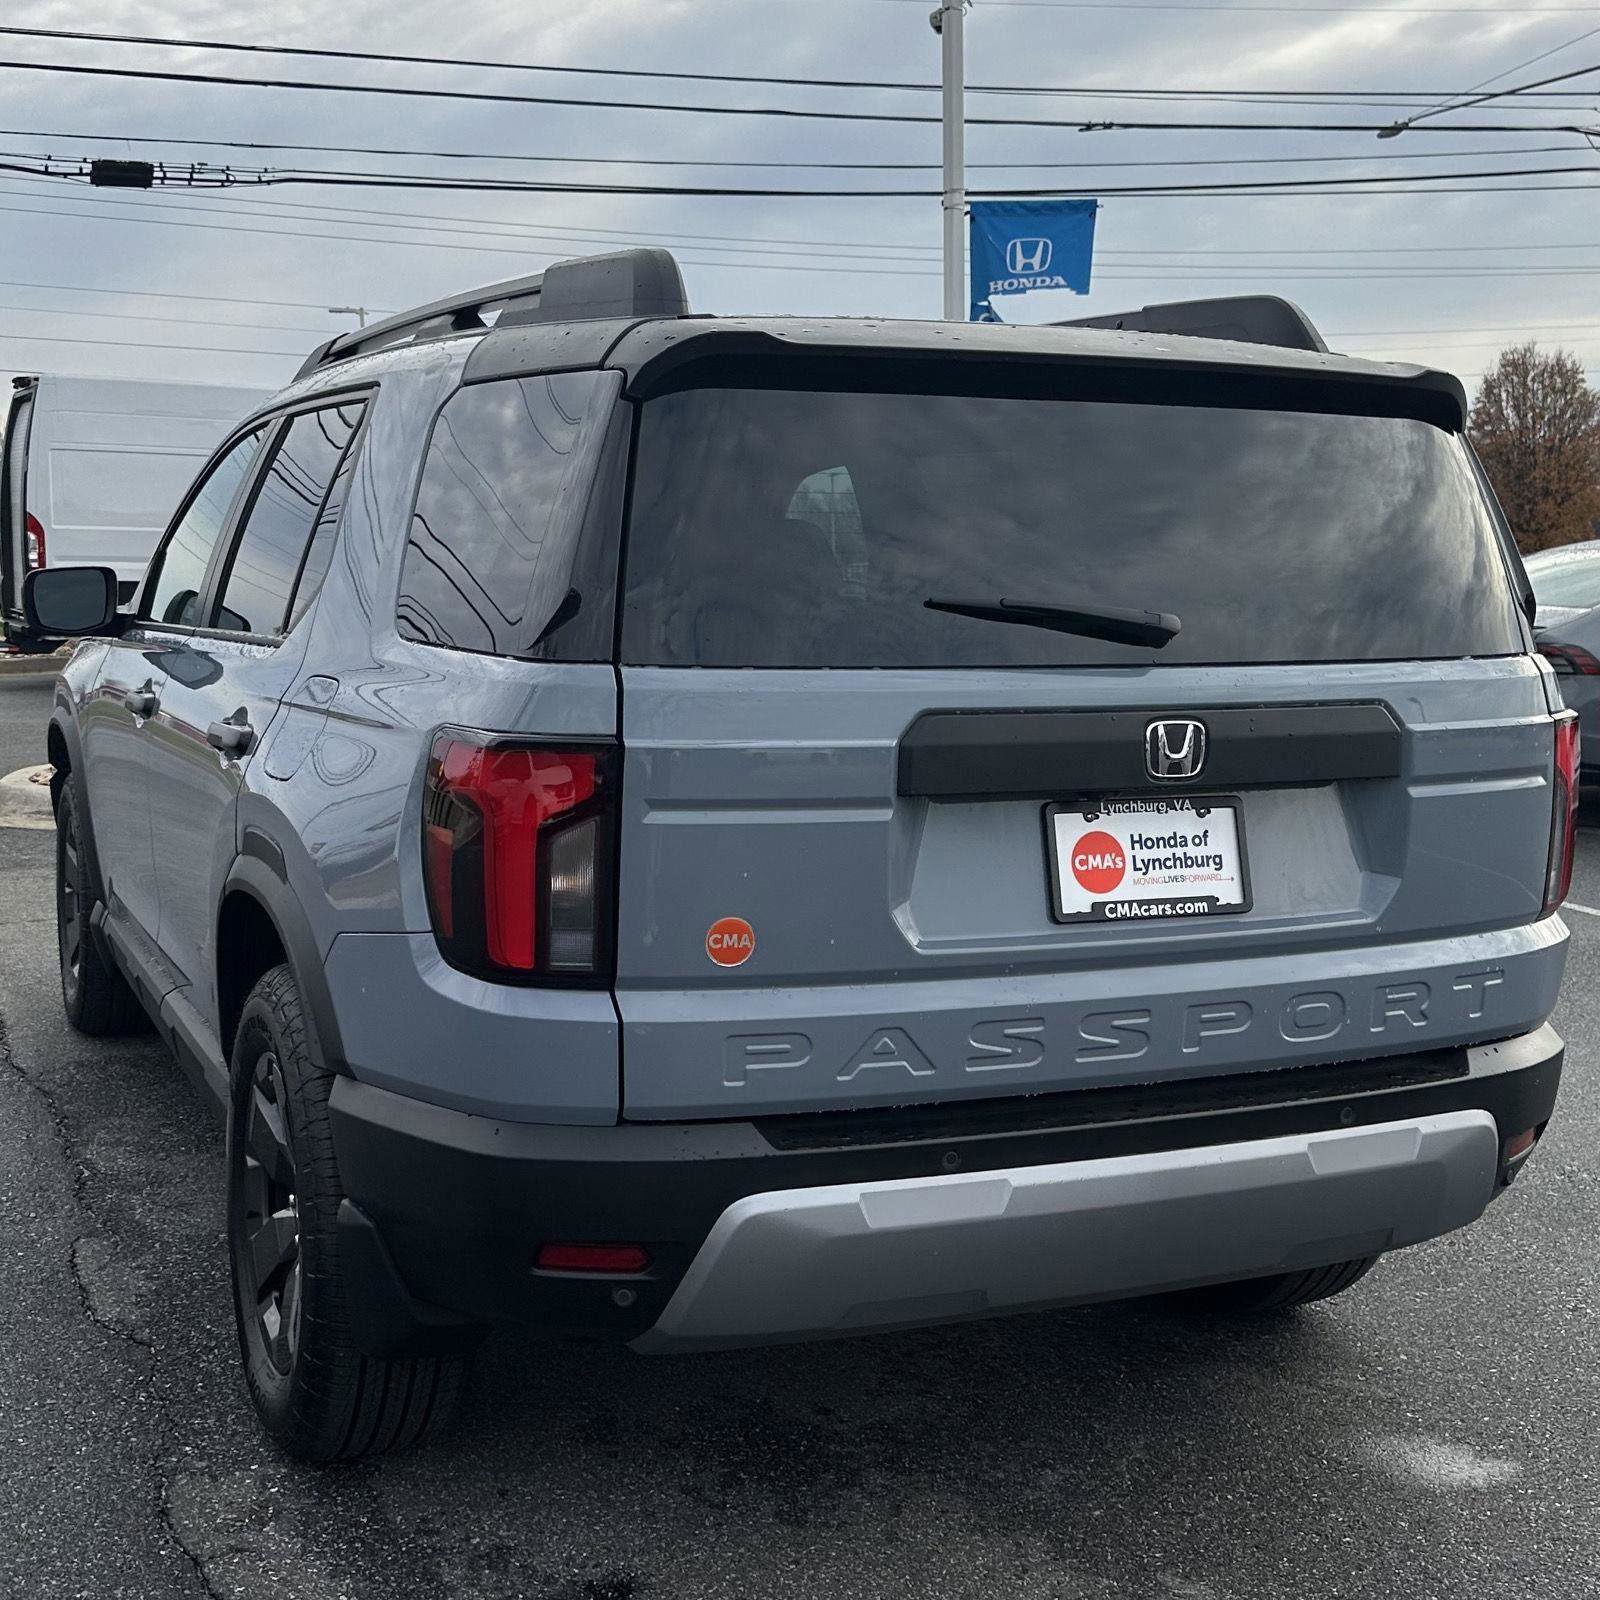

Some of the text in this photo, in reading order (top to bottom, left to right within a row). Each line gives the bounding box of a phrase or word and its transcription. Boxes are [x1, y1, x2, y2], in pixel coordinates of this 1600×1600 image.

[989, 276, 1067, 293] HONDA
[1173, 798, 1193, 811] VA
[1130, 830, 1208, 850] Honda of
[1074, 853, 1124, 871] CMA's
[1132, 852, 1223, 876] Lynchburg
[1105, 901, 1208, 919] CMAcars.com
[708, 933, 752, 949] CMA
[722, 971, 1504, 1088] PASSPORT
